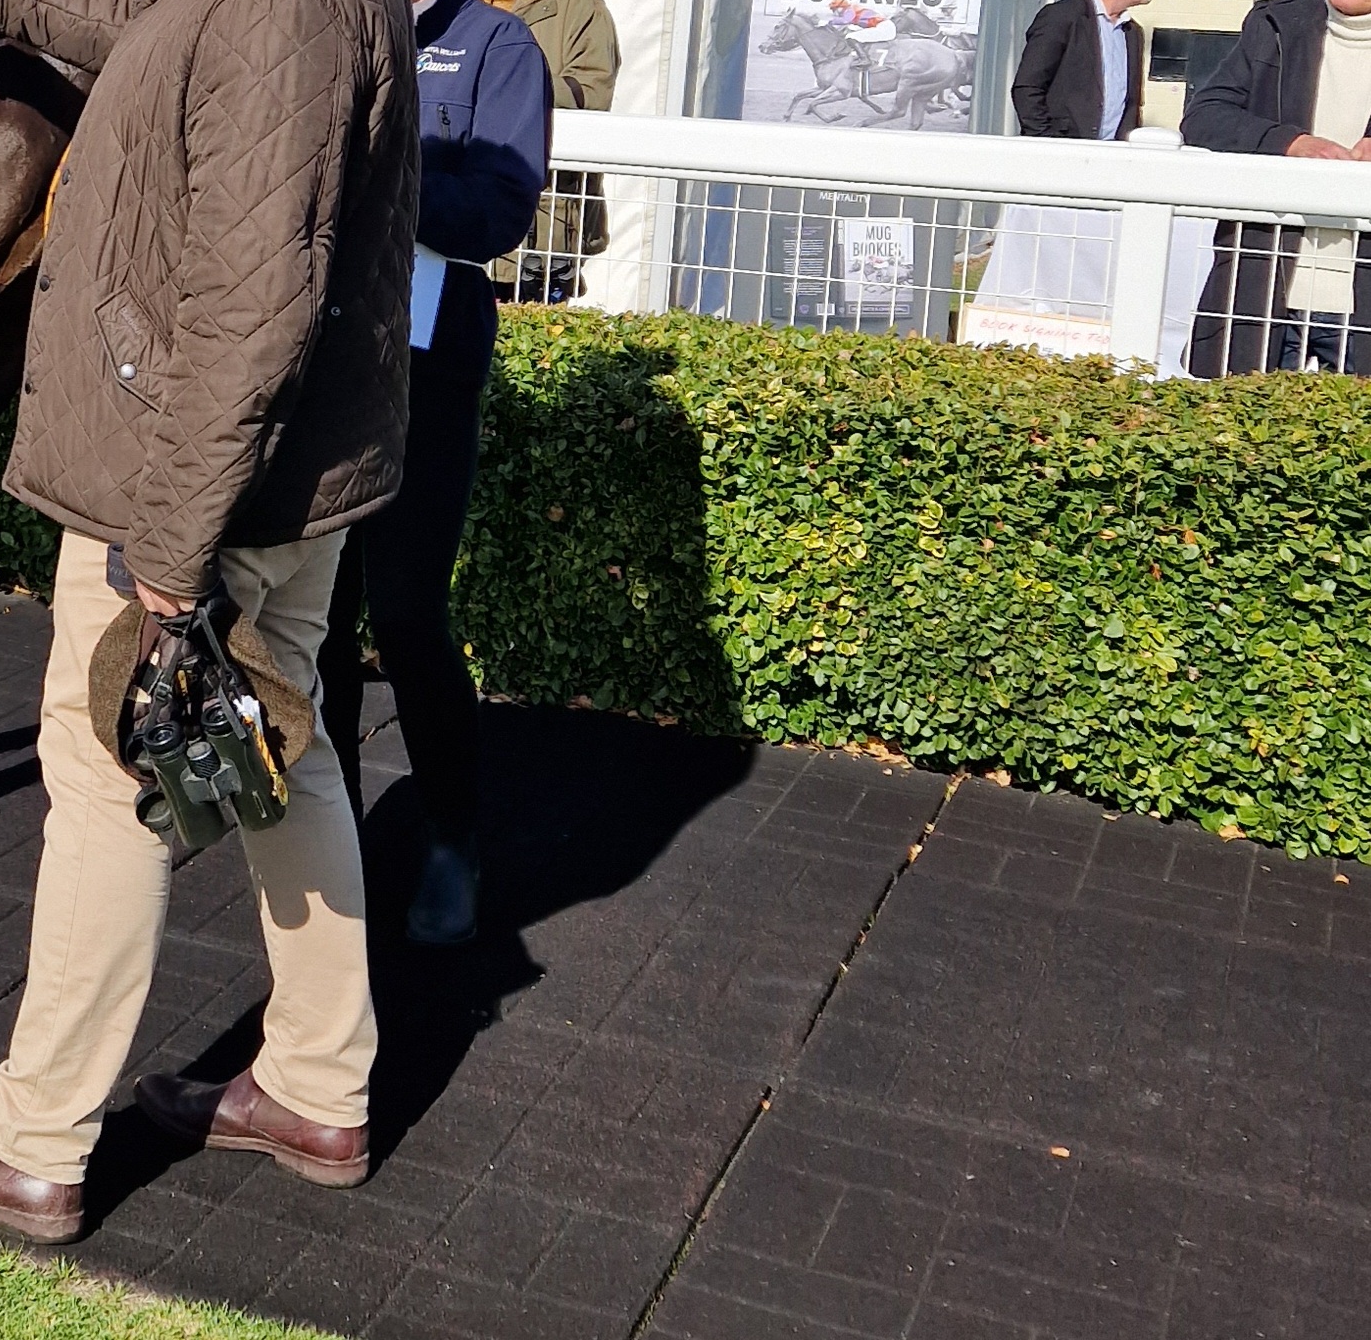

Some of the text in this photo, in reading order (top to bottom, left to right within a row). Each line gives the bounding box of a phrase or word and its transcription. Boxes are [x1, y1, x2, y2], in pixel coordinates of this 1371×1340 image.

[876, 49, 889, 67] 7
[865, 225, 891, 241] MUG
[979, 317, 1017, 333] BOOK
[1023, 324, 1081, 341] SIGNING
